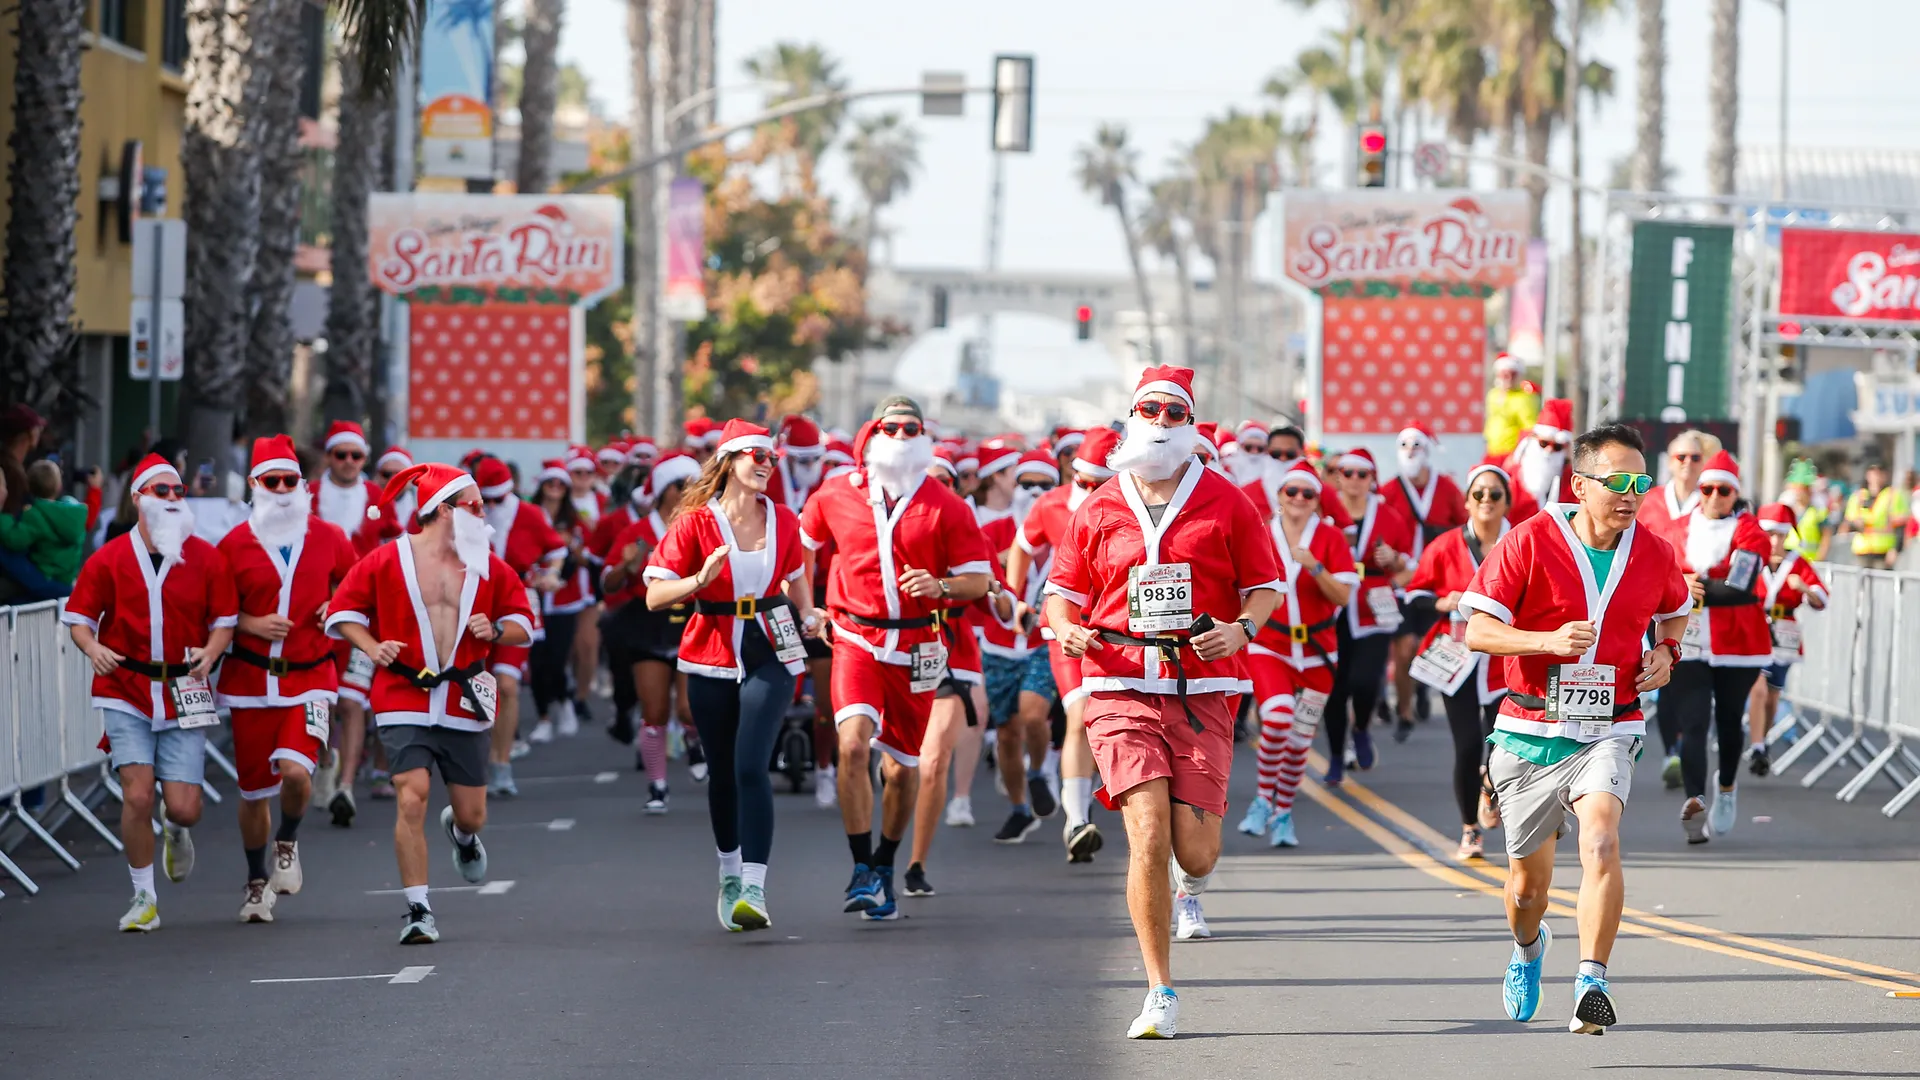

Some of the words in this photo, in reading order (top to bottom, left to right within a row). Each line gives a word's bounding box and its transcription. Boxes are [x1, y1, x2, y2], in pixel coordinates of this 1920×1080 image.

[384, 229, 503, 285] Santa
[510, 224, 600, 276] Run
[1297, 225, 1417, 279] Santa
[1424, 218, 1514, 270] Run
[1832, 251, 1920, 316] San
[1144, 586, 1187, 602] 9836
[184, 691, 211, 705] 8580
[1563, 688, 1611, 706] 7798
